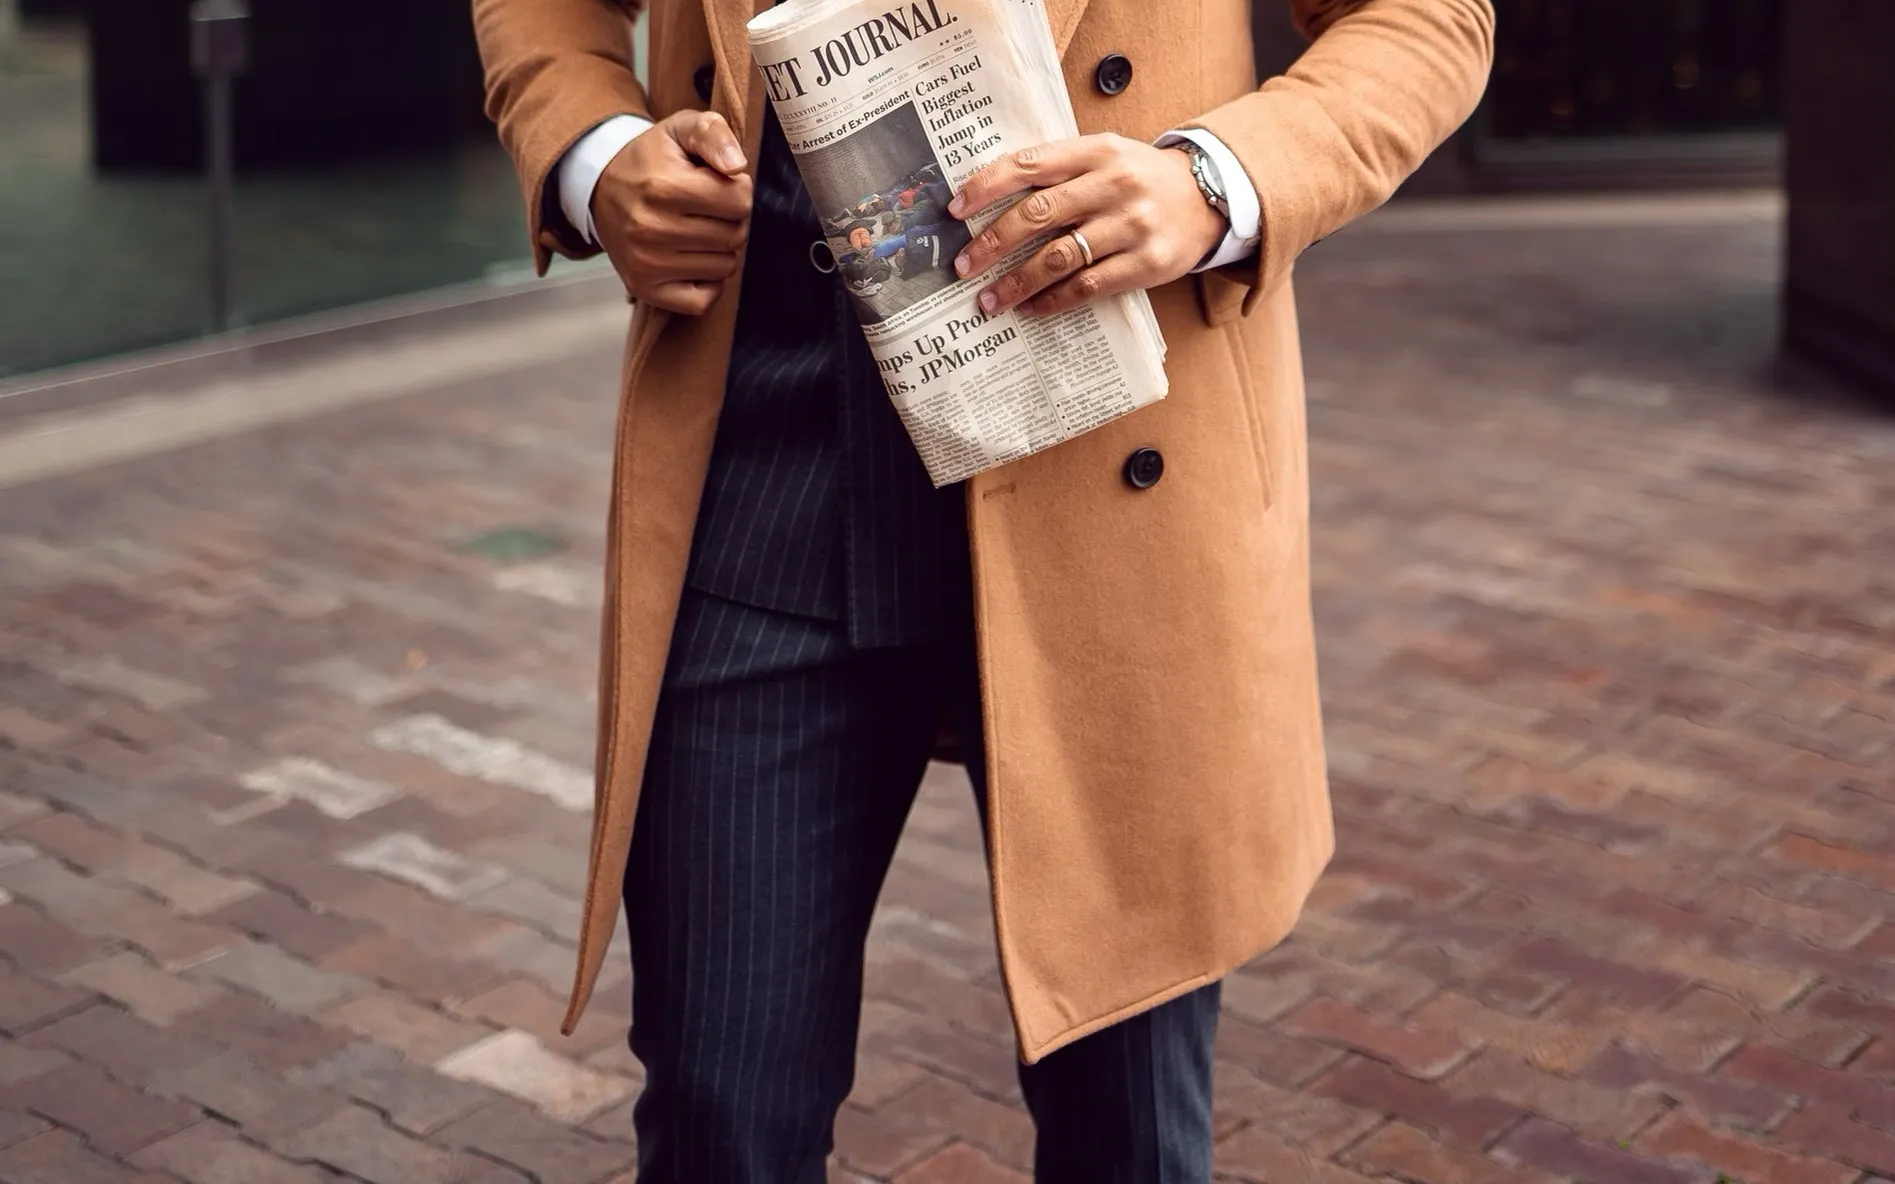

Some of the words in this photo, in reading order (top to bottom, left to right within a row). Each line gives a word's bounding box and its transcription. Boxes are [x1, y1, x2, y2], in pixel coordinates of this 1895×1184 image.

[915, 74, 948, 96] Cars
[949, 55, 981, 79] Fuel
[921, 81, 974, 114] Biggest
[929, 95, 992, 131] Inflation
[802, 131, 834, 149] Arrest
[836, 123, 847, 135] of
[848, 90, 911, 128] Ex-President
[938, 125, 975, 149] Jump
[976, 115, 992, 128] in
[944, 149, 961, 167] 13
[961, 133, 1001, 157] Years
[952, 173, 967, 183] Rise
[884, 378, 916, 396] hs,
[919, 327, 1017, 384] JPMorgan
[913, 334, 945, 356] Up
